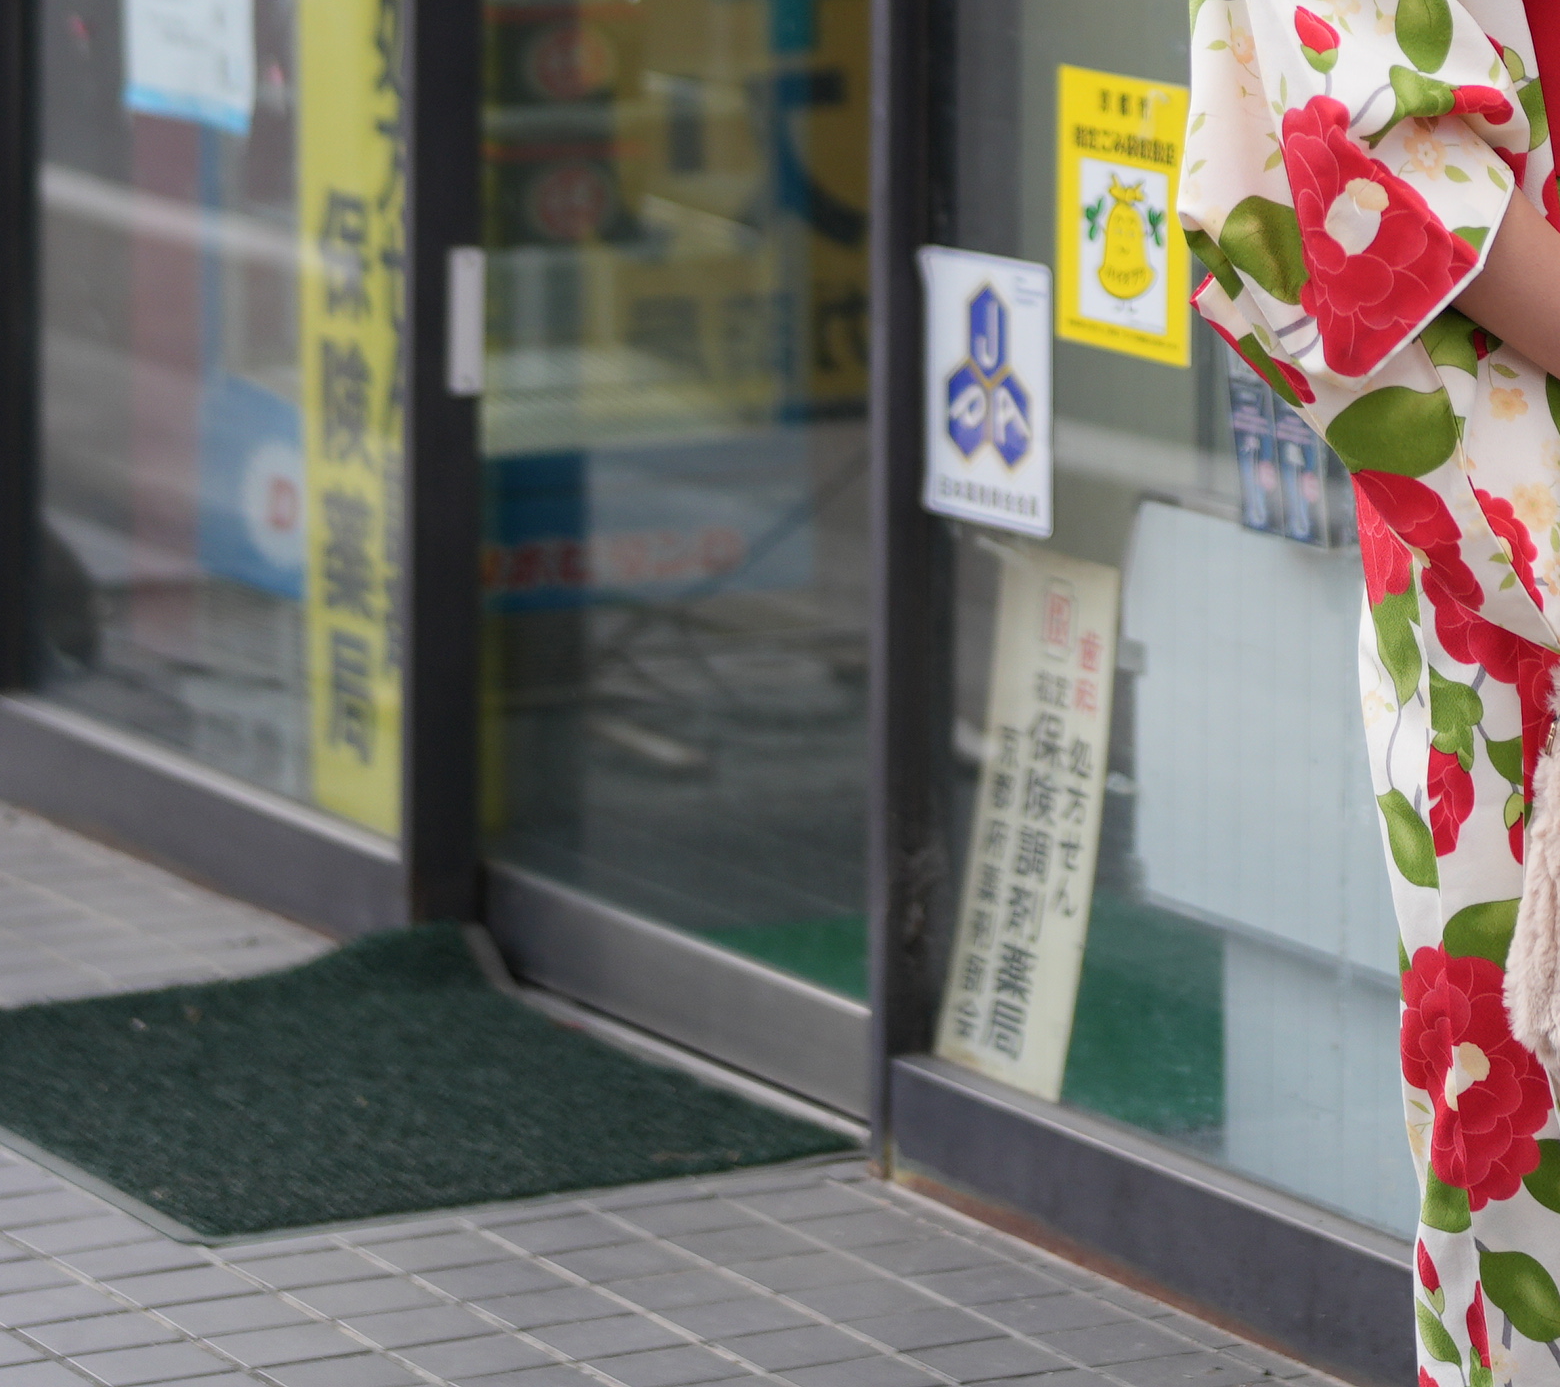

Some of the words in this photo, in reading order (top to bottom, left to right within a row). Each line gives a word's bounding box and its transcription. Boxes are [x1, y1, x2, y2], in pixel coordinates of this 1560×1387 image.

[984, 713, 1069, 1063] 保険調剤薬局
[1047, 739, 1094, 919] 処方せん
